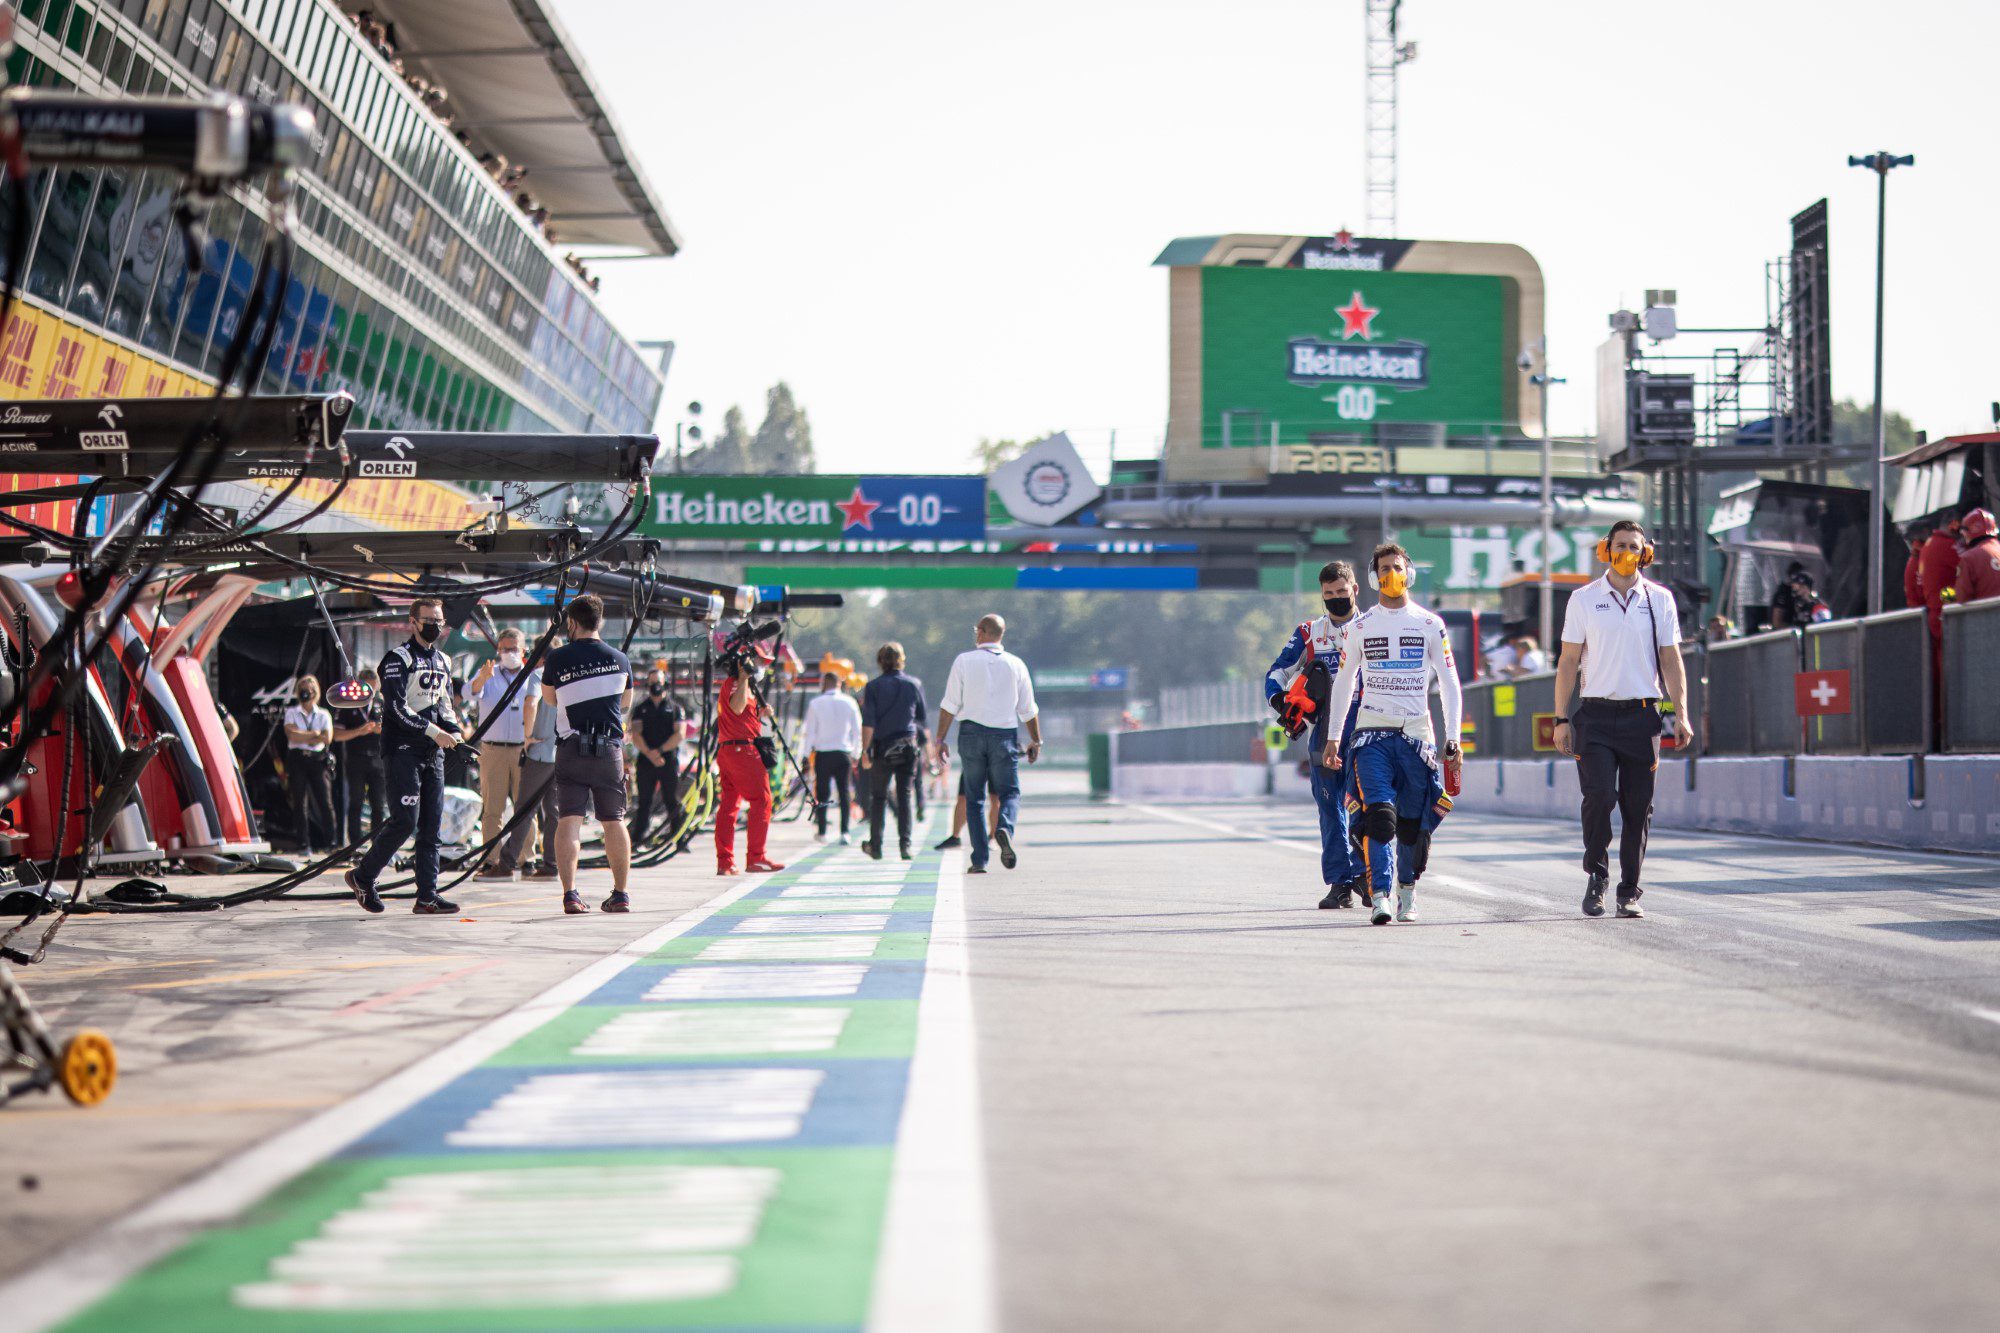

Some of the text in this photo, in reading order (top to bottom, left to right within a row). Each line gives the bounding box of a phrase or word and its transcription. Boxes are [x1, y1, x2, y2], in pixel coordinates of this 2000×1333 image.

[1293, 346, 1422, 379] Heineken
[3, 406, 51, 424] Romeo
[0, 443, 38, 451] ACING
[83, 435, 124, 448] ORLEN
[362, 463, 412, 475] ORLEN
[655, 493, 832, 524] Heineken
[572, 664, 620, 679] ALPHATAURI
[1366, 676, 1425, 685] ACCELERATING
[1366, 683, 1424, 691] TRANSFORMATION
